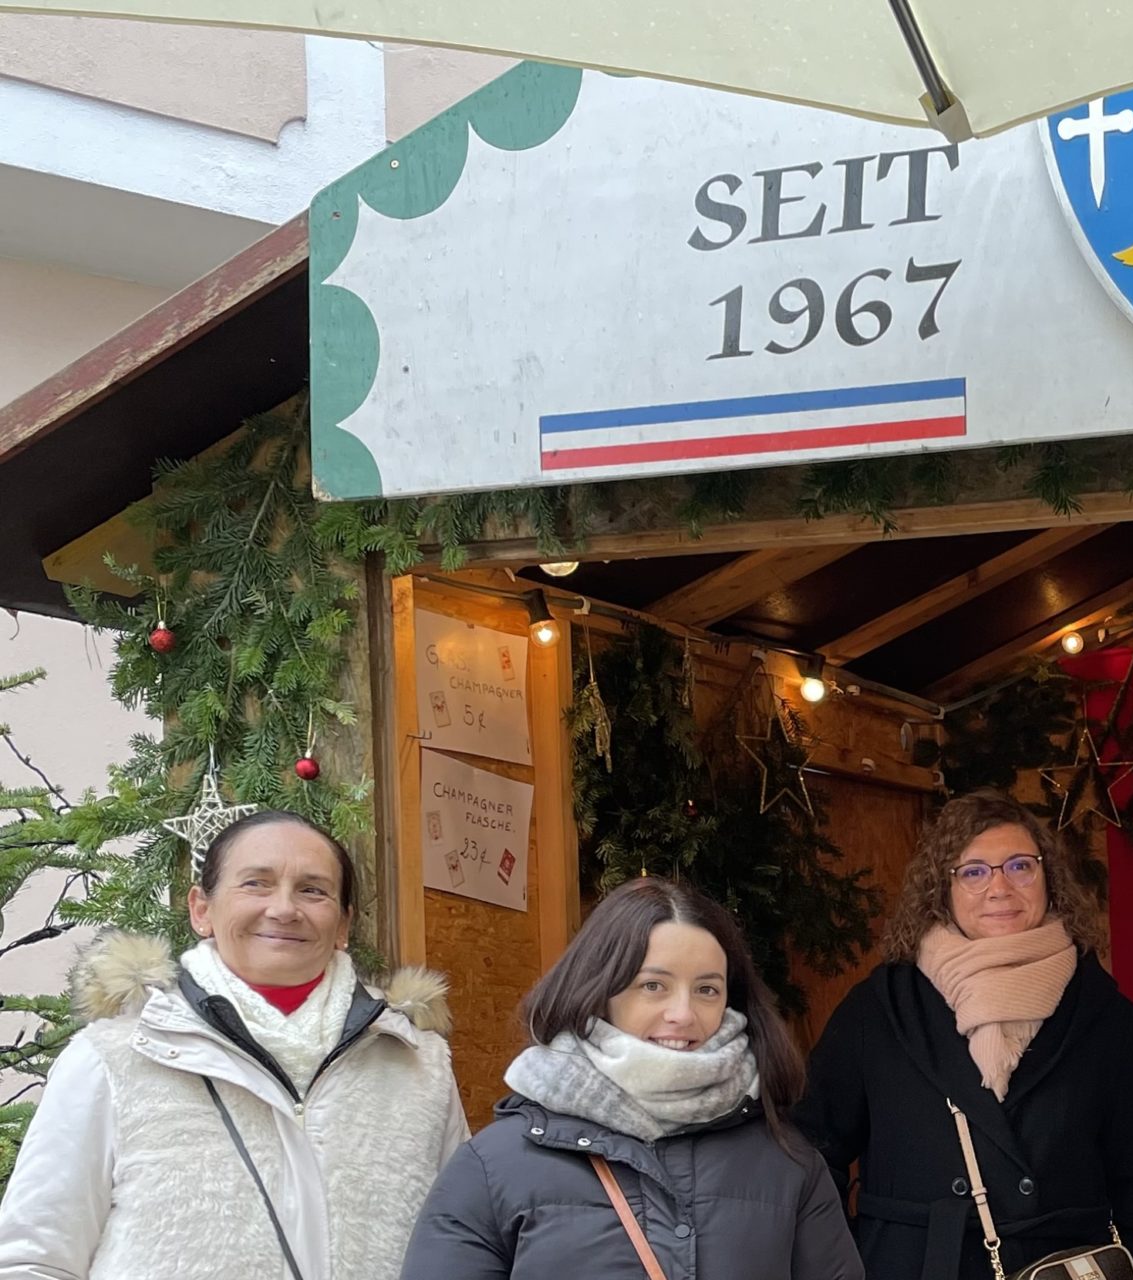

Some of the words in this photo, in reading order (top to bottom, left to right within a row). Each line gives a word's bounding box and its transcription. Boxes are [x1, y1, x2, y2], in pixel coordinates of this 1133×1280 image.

[686, 142, 960, 251] SEIT
[705, 256, 963, 361] 1967
[449, 675, 523, 702] CHAMPAGNER
[433, 782, 514, 817] CHAMPAGNER
